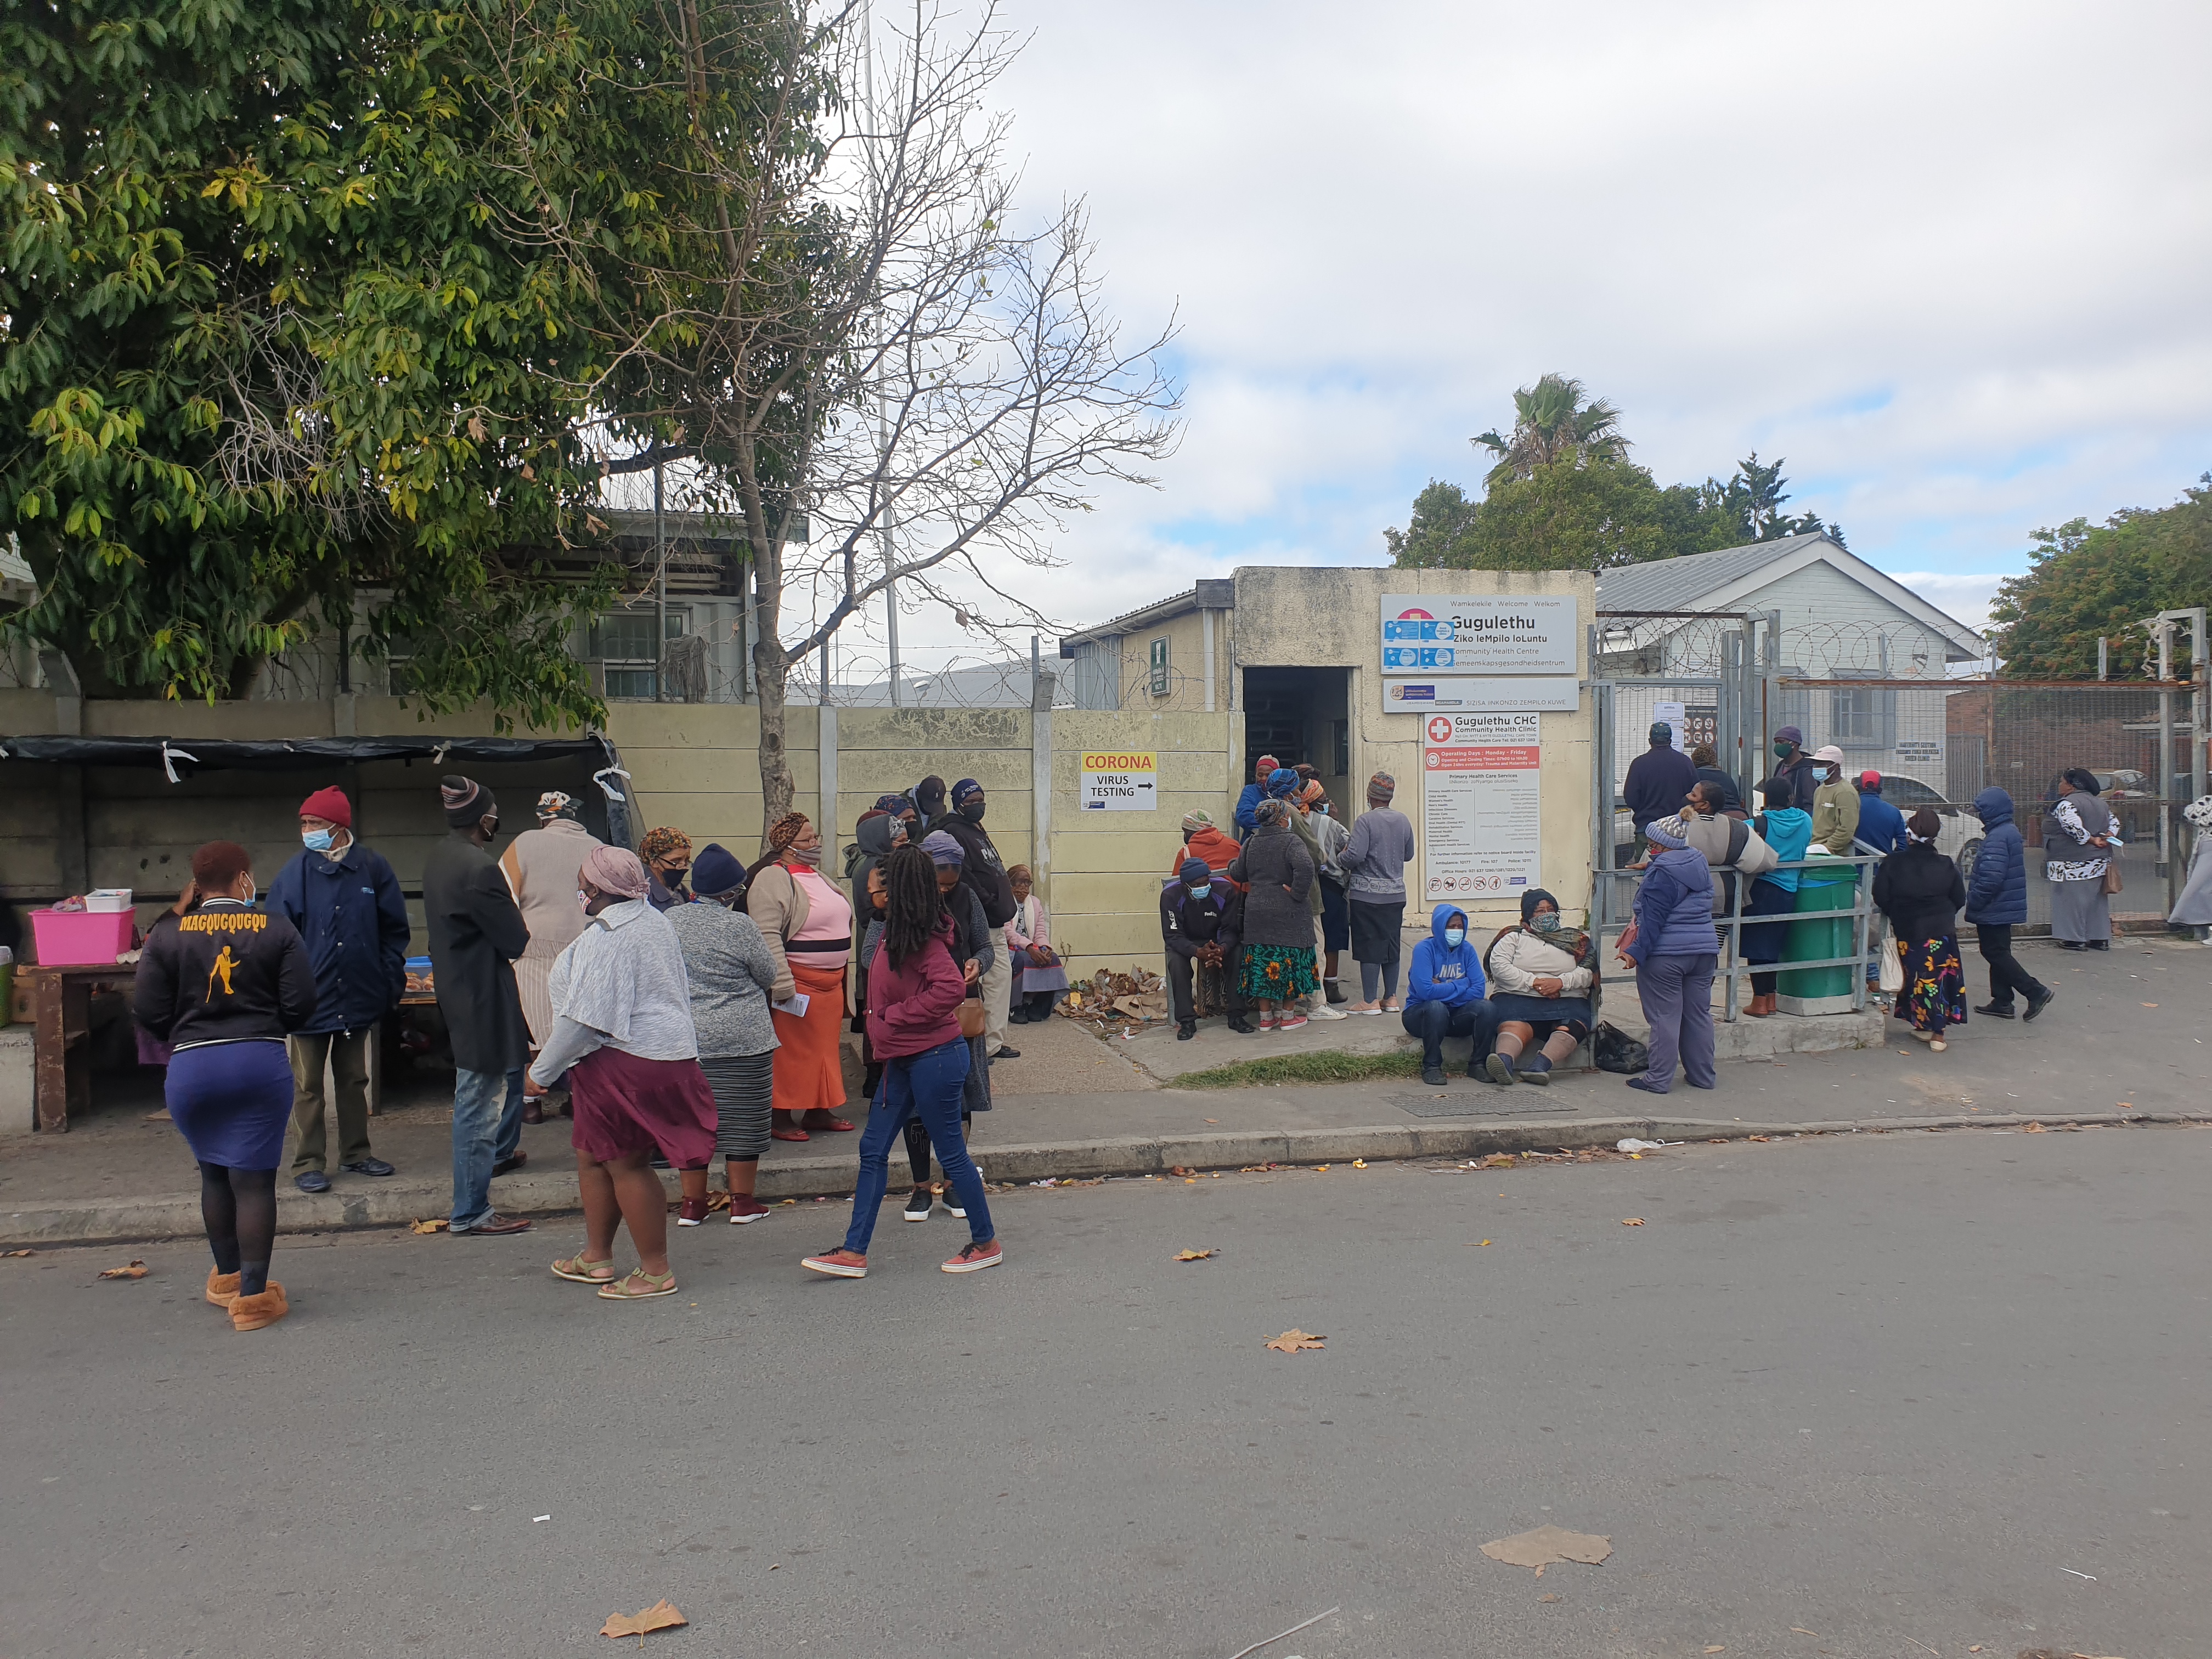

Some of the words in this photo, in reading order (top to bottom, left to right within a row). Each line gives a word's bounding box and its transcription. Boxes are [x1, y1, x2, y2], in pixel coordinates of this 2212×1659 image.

[1452, 616, 1535, 631] Gugulethu
[1455, 716, 1510, 727] Gugulethu
[1514, 716, 1537, 725] CHC
[1085, 755, 1152, 769] CORONA
[1097, 776, 1128, 785] VIRUS
[1091, 787, 1134, 797] TESTING
[179, 913, 267, 936] MAGQUGQUGQU
[1438, 962, 1462, 978] NIKE
